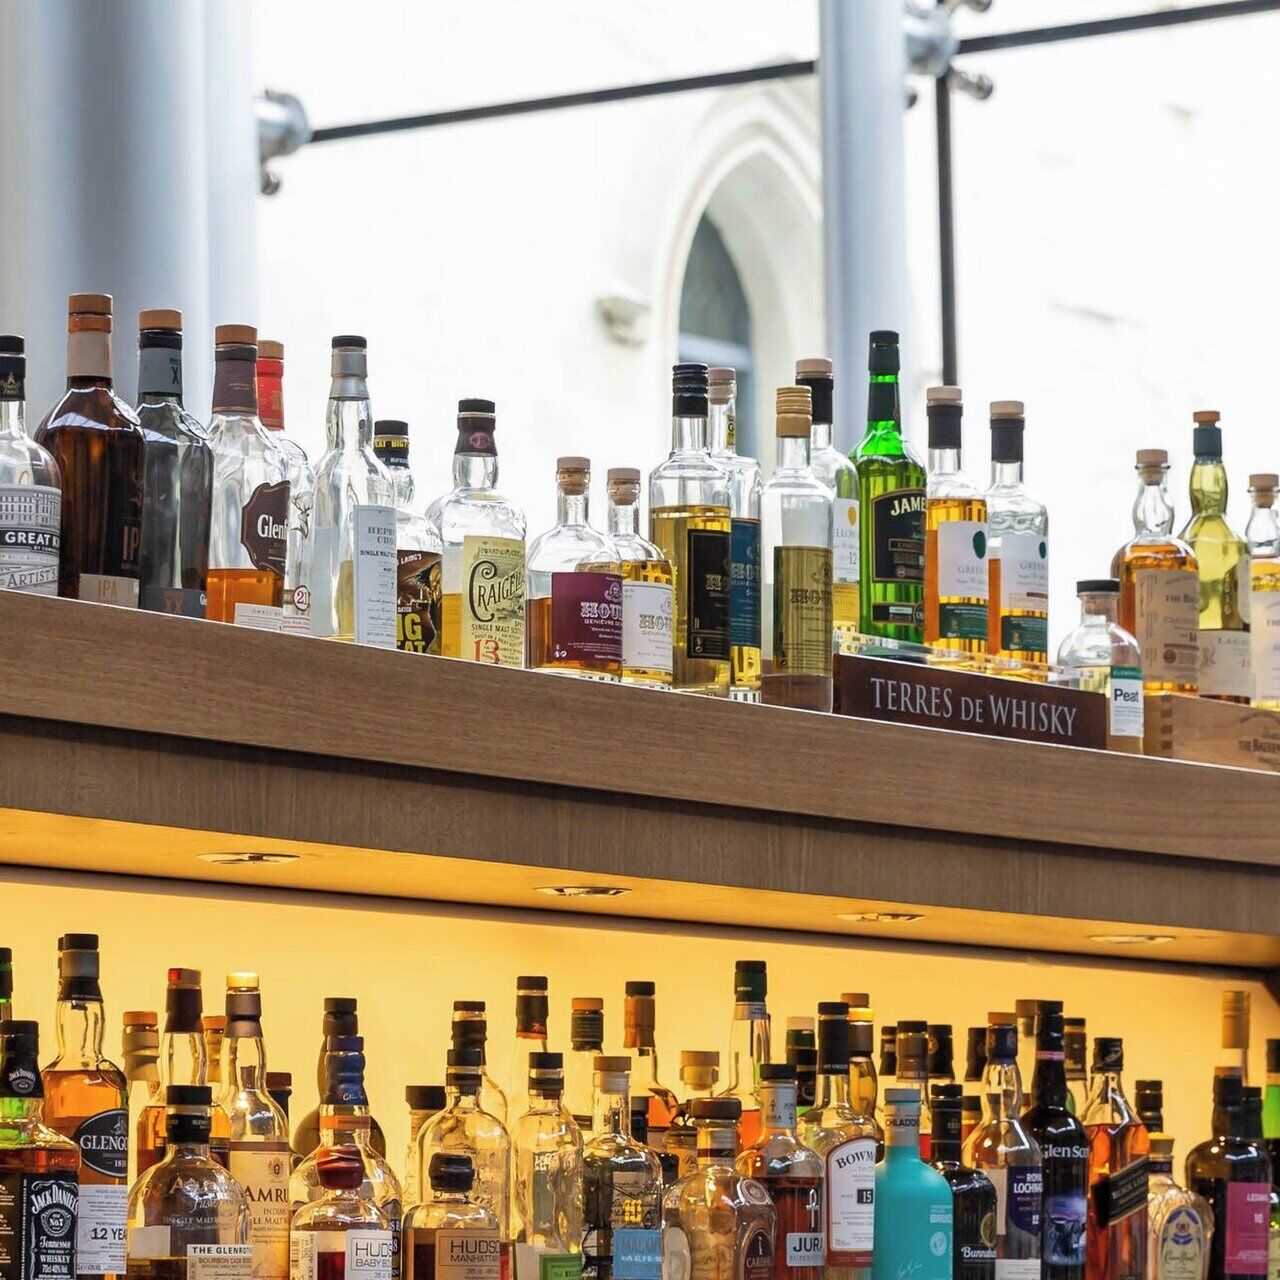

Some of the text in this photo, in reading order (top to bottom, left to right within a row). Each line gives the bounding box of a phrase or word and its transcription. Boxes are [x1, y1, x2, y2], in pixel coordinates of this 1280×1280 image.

[4, 531, 49, 546] GREAT
[397, 613, 423, 640] IG
[474, 639, 500, 664] 13
[1114, 688, 1139, 702] Peat
[871, 677, 1077, 736] TERRES DE WHISKY
[31, 1191, 52, 1215] JACK
[91, 1228, 108, 1240] 12
[193, 1246, 213, 1254] THE
[40, 1254, 71, 1264] WHISKEY
